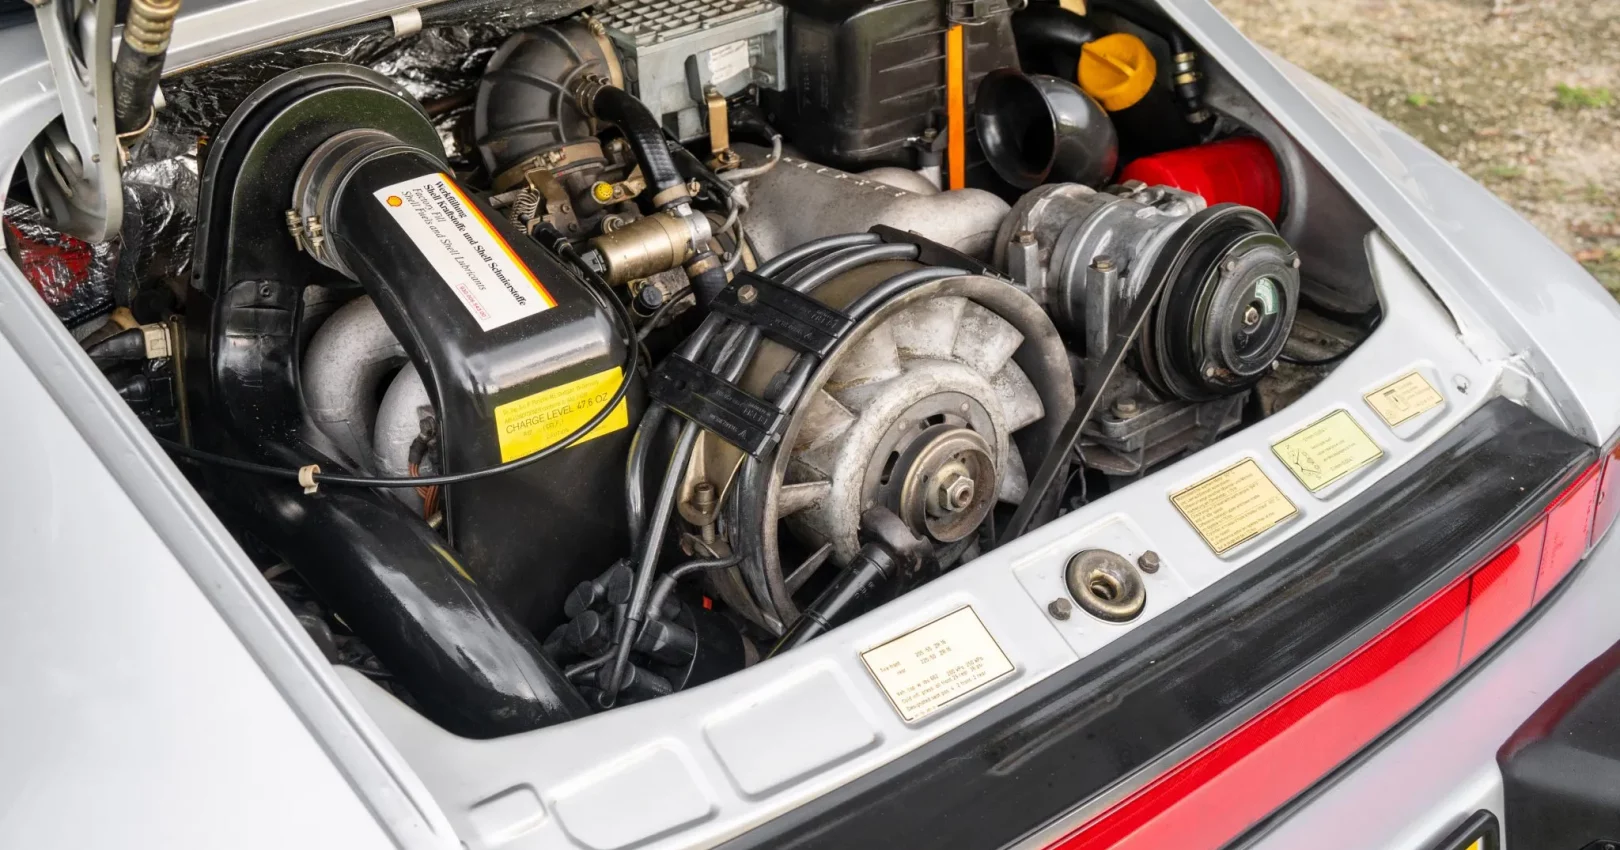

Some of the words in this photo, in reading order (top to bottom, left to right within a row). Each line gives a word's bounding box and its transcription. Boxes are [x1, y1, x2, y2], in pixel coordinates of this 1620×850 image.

[412, 187, 433, 211] Factory
[431, 211, 447, 223] Fill
[435, 181, 467, 219] Werkfüllung
[401, 190, 420, 211] Shell
[415, 207, 432, 226] Fuels
[429, 224, 444, 238] and
[441, 238, 460, 257] Shell
[454, 256, 487, 291] Lubricants
[423, 184, 442, 204] Shell
[437, 200, 466, 232] Kraftstoffe
[463, 232, 478, 246] und
[473, 244, 492, 264] Shell
[488, 262, 526, 306] Schmierstoffe
[506, 413, 545, 434] CHARGE
[546, 405, 574, 420] LEVEL
[595, 392, 608, 404] OZ
